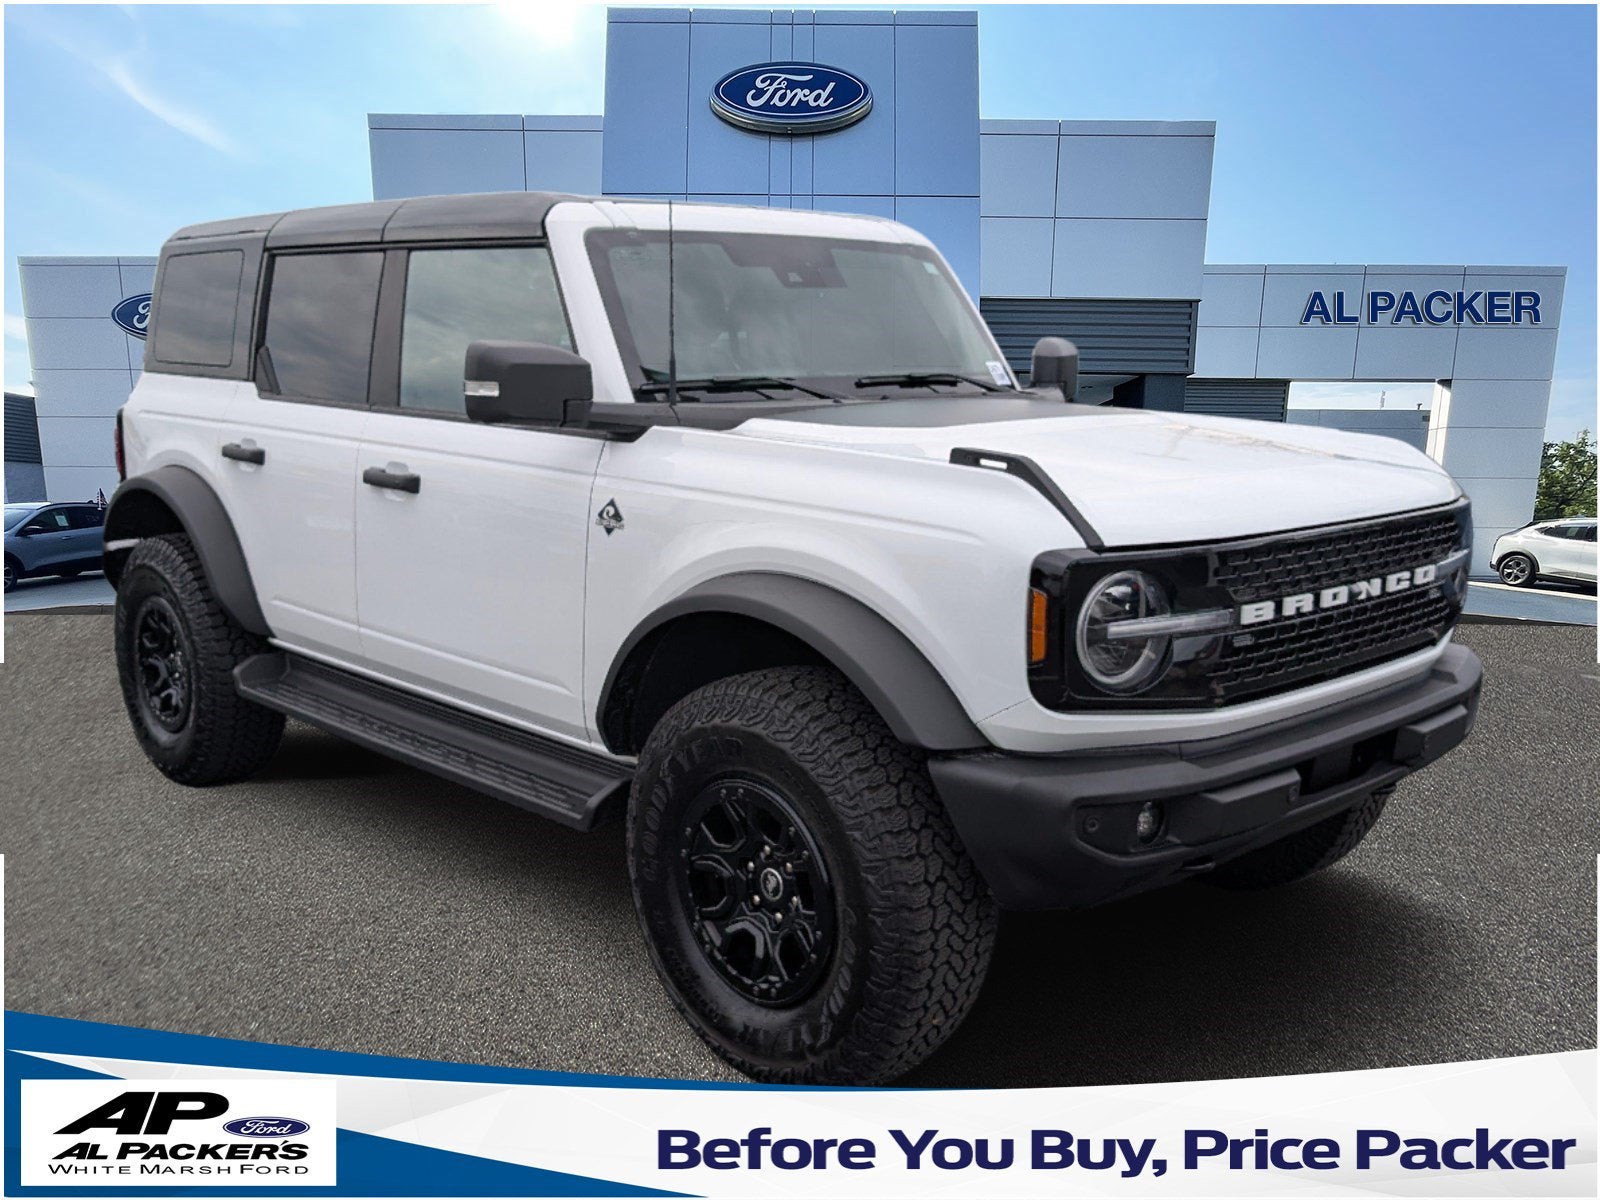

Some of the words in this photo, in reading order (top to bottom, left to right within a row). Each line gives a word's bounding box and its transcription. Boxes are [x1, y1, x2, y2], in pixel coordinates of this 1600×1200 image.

[746, 72, 836, 108] Ford
[1301, 291, 1360, 324] AL
[1368, 290, 1542, 325] PACKER
[1240, 564, 1437, 625] BRONCO
